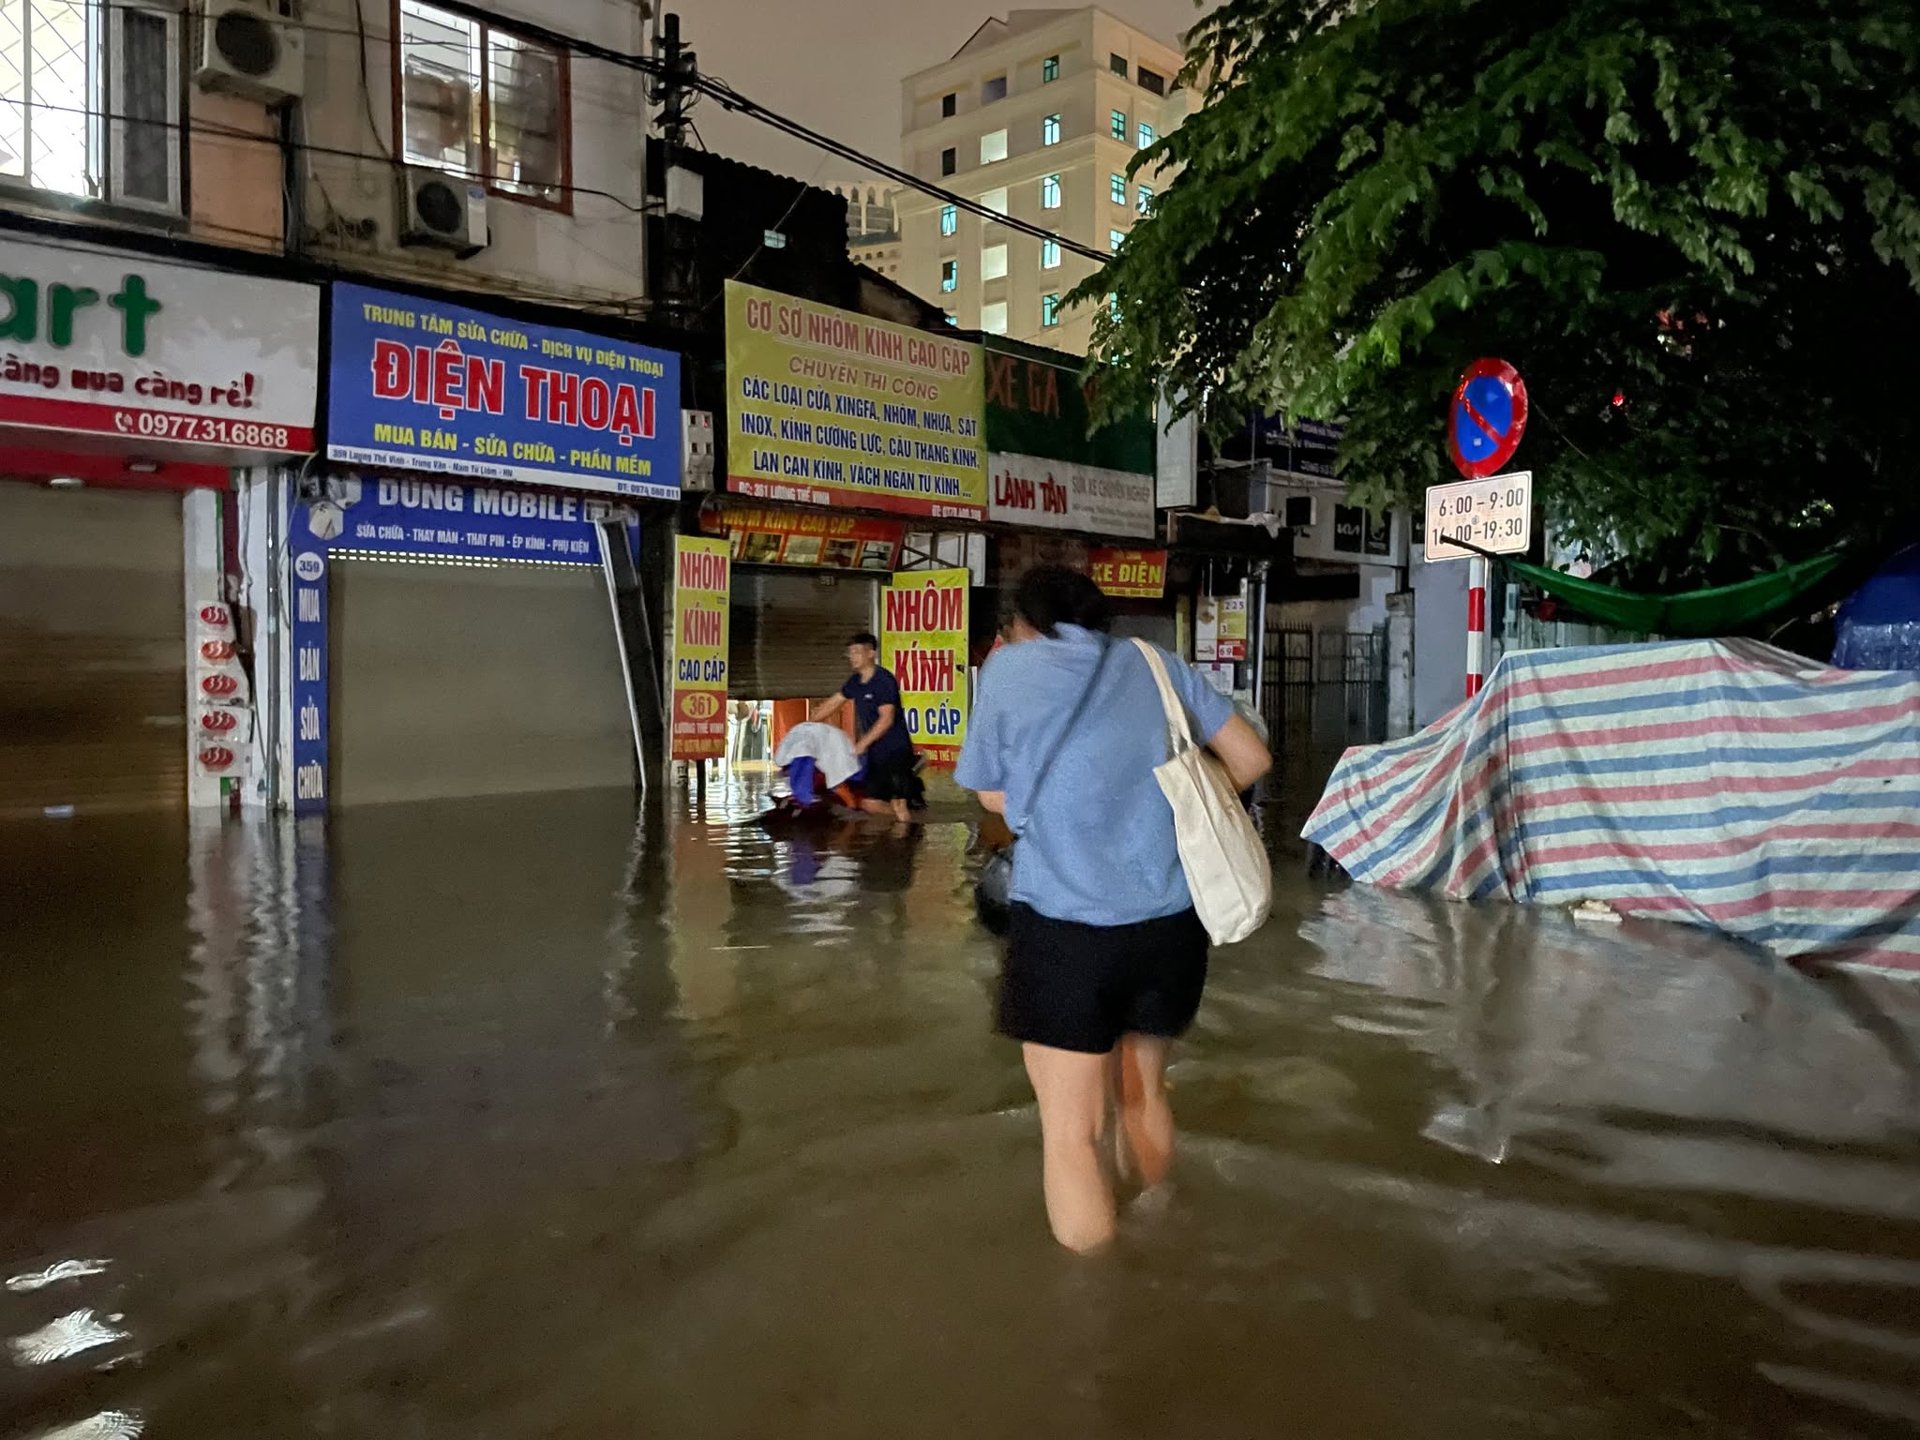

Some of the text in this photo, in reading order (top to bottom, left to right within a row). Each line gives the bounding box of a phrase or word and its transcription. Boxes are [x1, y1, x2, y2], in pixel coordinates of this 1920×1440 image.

[363, 304, 415, 327] TRUNG
[420, 314, 452, 334] TÂM
[457, 320, 486, 342] SỬA
[542, 339, 572, 359] DỊCH
[576, 346, 592, 365] VỤ
[596, 350, 625, 370] ĐIỆN
[629, 357, 663, 379] THOẠI
[747, 298, 772, 331] CƠ
[779, 299, 802, 338] SỞ
[808, 314, 859, 352] NHÔM
[908, 338, 937, 368] CAO
[0, 354, 254, 407] àng mua càng rẻ!
[371, 338, 656, 447] ĐIỆN THOẠI
[743, 375, 769, 400] CÁC
[774, 382, 802, 410] LOẠI
[807, 385, 831, 411] CỬA
[835, 394, 879, 422] XINGFA,
[790, 356, 938, 400] CHUYÊN THI CÔNG
[984, 351, 1018, 410] XE
[138, 412, 288, 448] 0977.31.6868
[374, 423, 415, 446] MUA
[420, 428, 457, 451] BÁN
[474, 433, 507, 457] SỬA
[513, 441, 555, 463] CHỮA
[741, 412, 776, 439] INOX,
[781, 417, 811, 442] KÍNH
[816, 424, 856, 449] CƯỜNG
[915, 442, 949, 463] THANG
[754, 450, 778, 473] LAN
[784, 455, 809, 477] CAN
[814, 456, 846, 483] KÍNH,
[850, 461, 880, 486] VÁCH
[934, 474, 960, 496] KÍNH
[995, 470, 1035, 510] LÀNH
[474, 488, 577, 522] MOBILE
[801, 513, 826, 532] CAO
[1439, 495, 1472, 517] 6:00
[1490, 488, 1523, 510] 9:00
[356, 521, 376, 538] SỬA
[413, 528, 435, 542] THAY
[467, 532, 487, 546] THAY
[490, 533, 505, 547] PIN
[513, 534, 523, 548] ÉP
[525, 535, 545, 550] KÍNH
[553, 539, 569, 554] PHỤ
[571, 539, 589, 555] KIỆN
[299, 561, 319, 572] 359
[680, 546, 727, 591] NHÔM
[1118, 561, 1162, 587] ĐIỆN
[683, 601, 721, 646] KÍNH
[886, 579, 963, 631] NHÔM
[300, 640, 320, 681] BÁN
[679, 652, 726, 682] CAO CẤP
[894, 640, 954, 692] KÍNH
[689, 695, 712, 716] 361
[925, 698, 961, 735] CẤP
